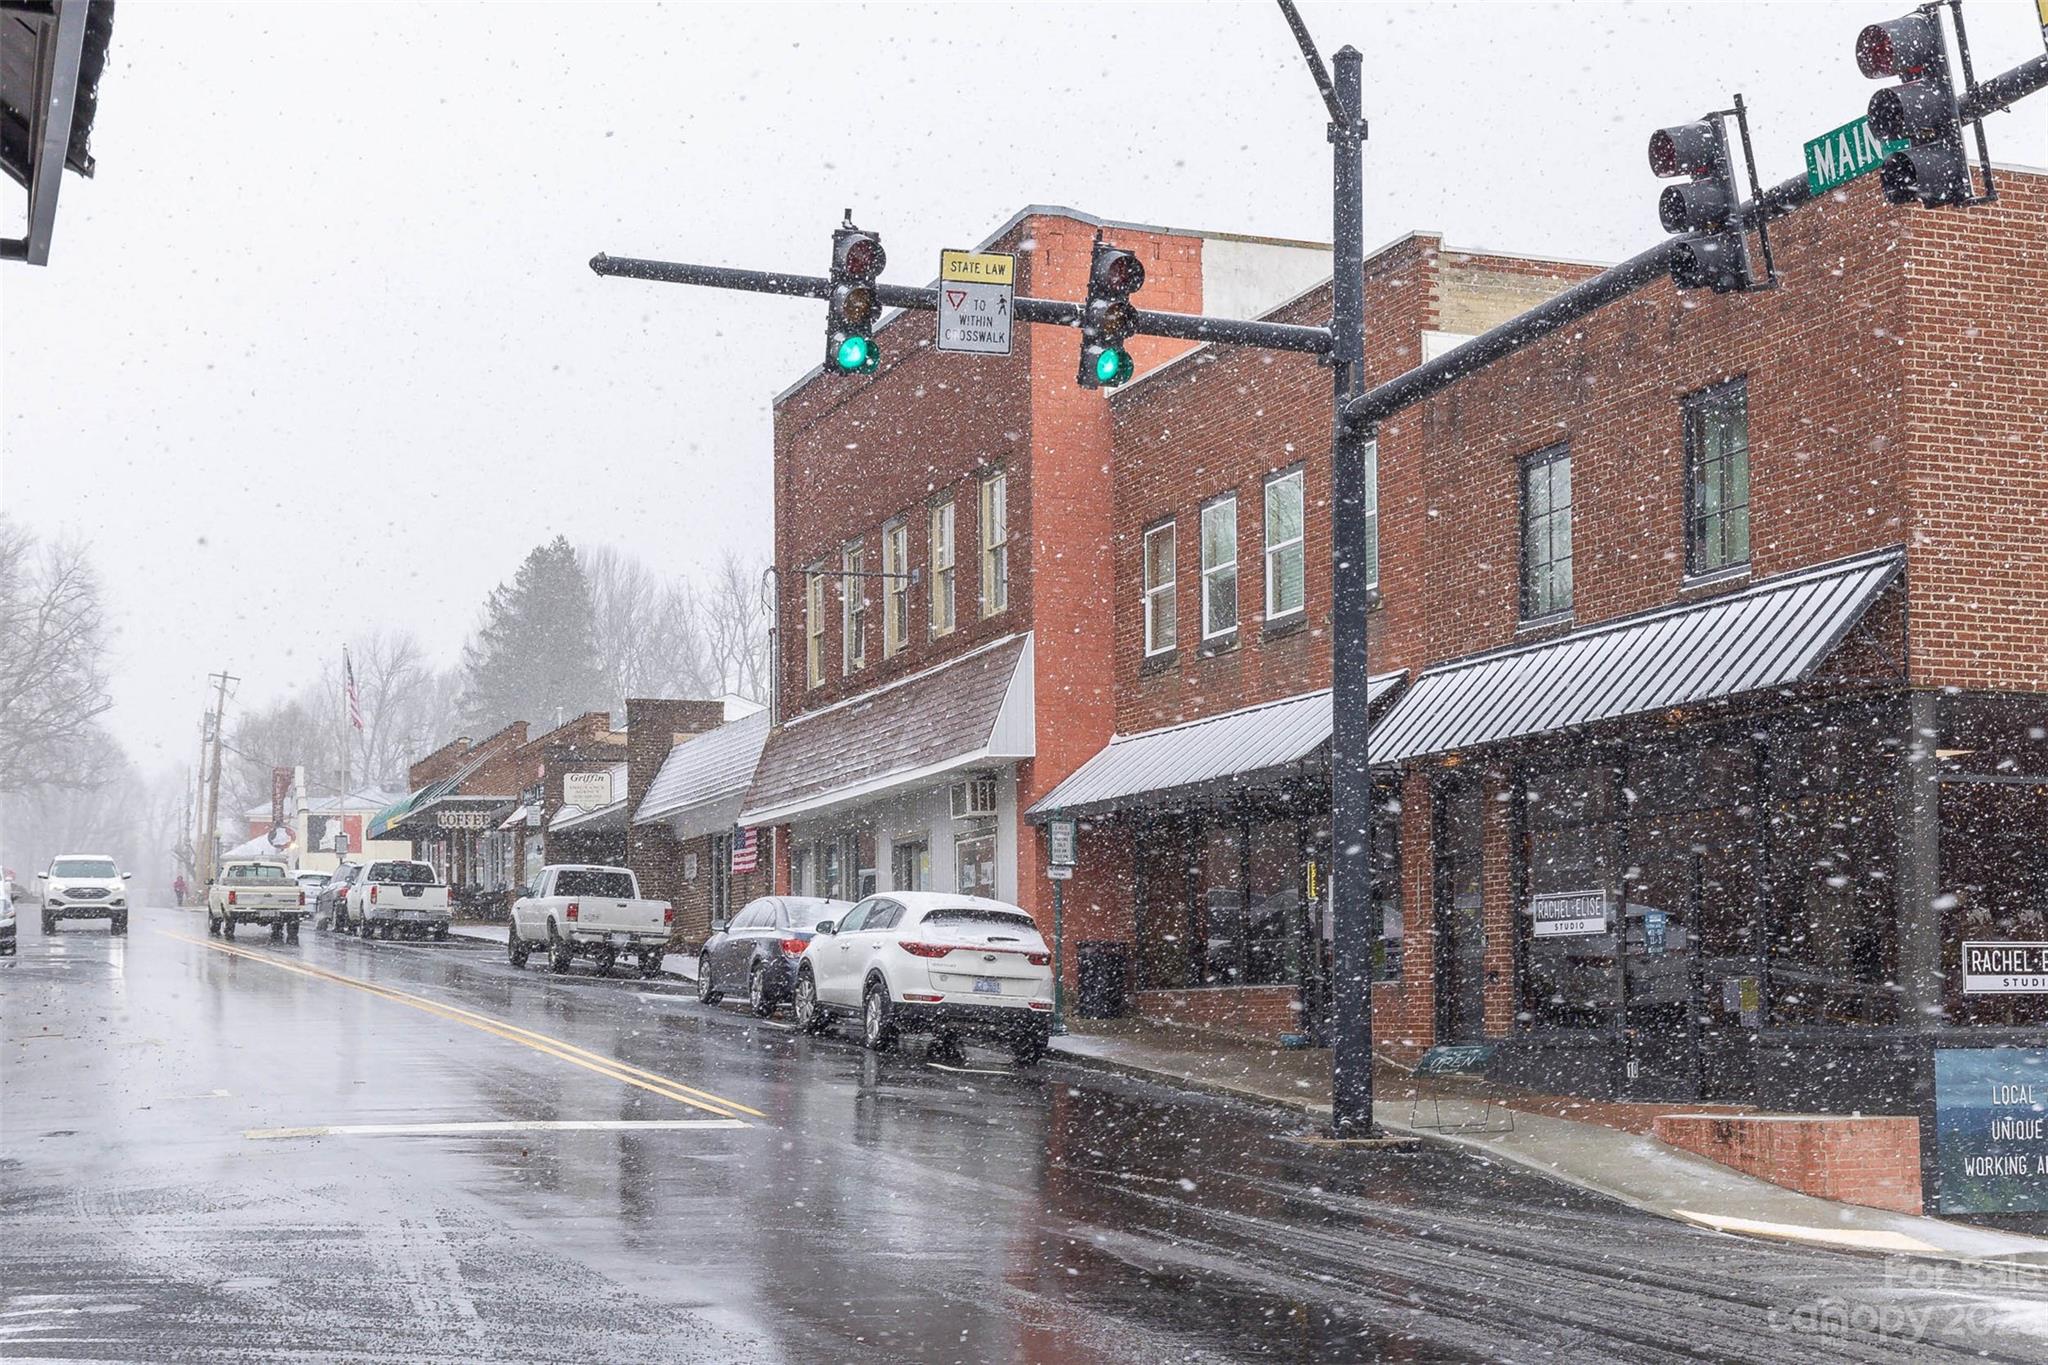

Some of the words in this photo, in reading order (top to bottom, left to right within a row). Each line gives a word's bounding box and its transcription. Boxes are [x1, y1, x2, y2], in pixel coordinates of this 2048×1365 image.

[1813, 121, 1883, 185] MAIN
[951, 261, 980, 273] STATE
[985, 264, 1005, 275] LAW
[974, 299, 986, 311] TO
[960, 315, 992, 327] WITHIN
[570, 774, 604, 784] Griffin
[438, 811, 490, 827] COFFEE
[1554, 922, 1584, 931] STUDIO
[1430, 1056, 1478, 1070] OPEN
[1992, 1085, 2036, 1105] LOCAL
[1991, 1120, 2043, 1140] UNIQUE
[1964, 1155, 2027, 1176] WORKING
